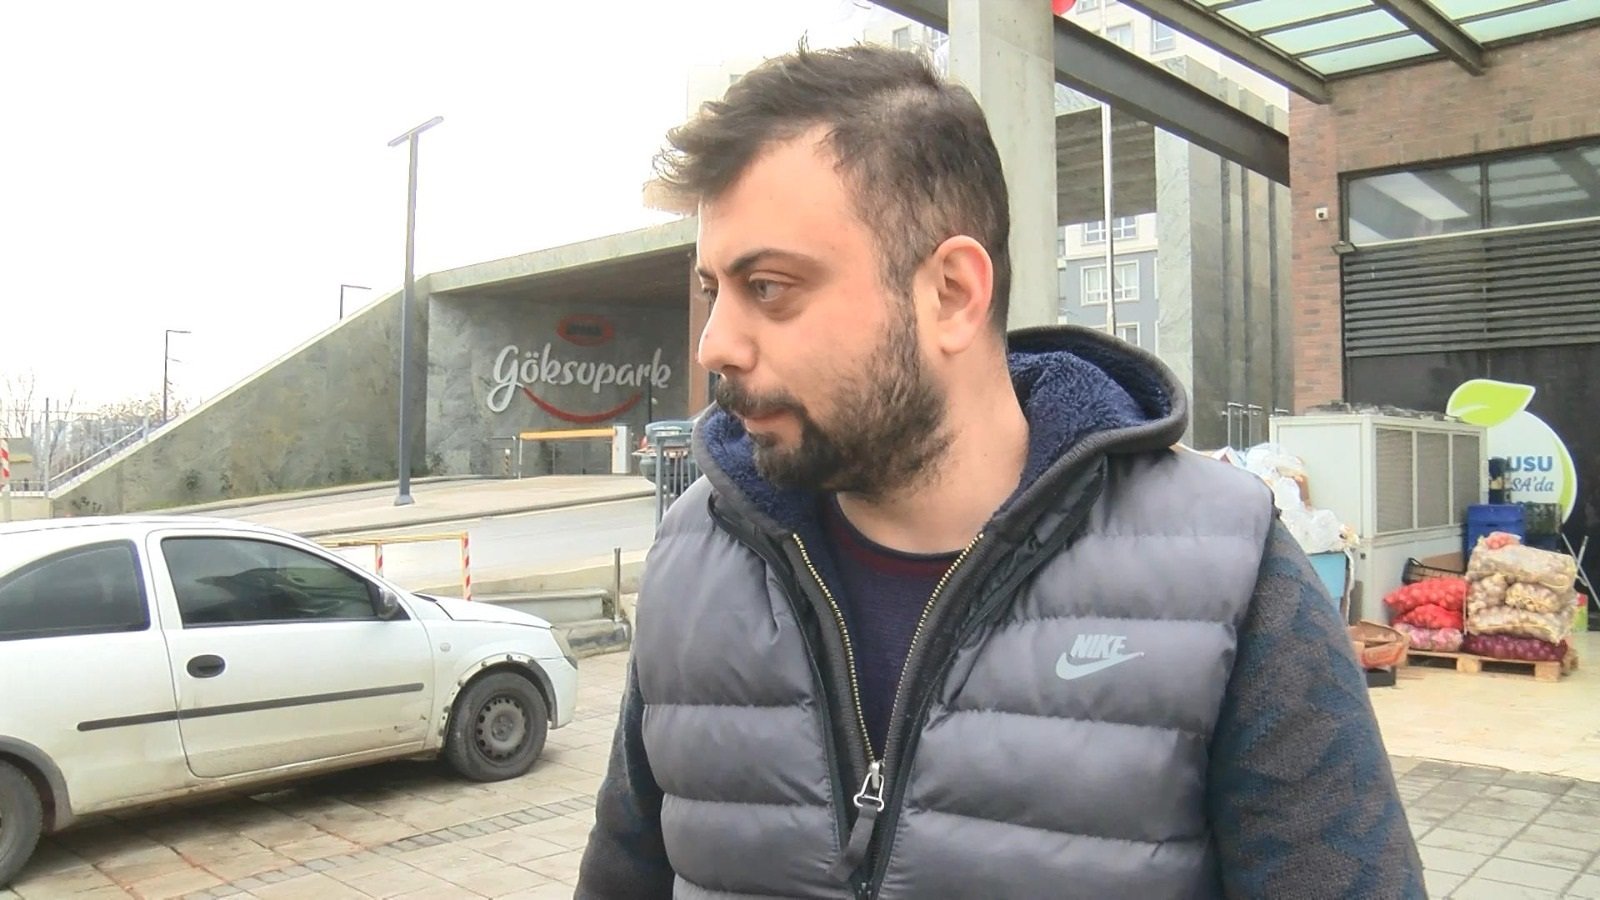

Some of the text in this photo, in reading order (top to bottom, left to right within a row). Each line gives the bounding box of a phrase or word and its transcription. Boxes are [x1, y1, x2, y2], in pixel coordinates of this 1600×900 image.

[1506, 456, 1553, 472] USU
[1511, 476, 1554, 492] SA'da
[1070, 634, 1127, 659] NIKE
